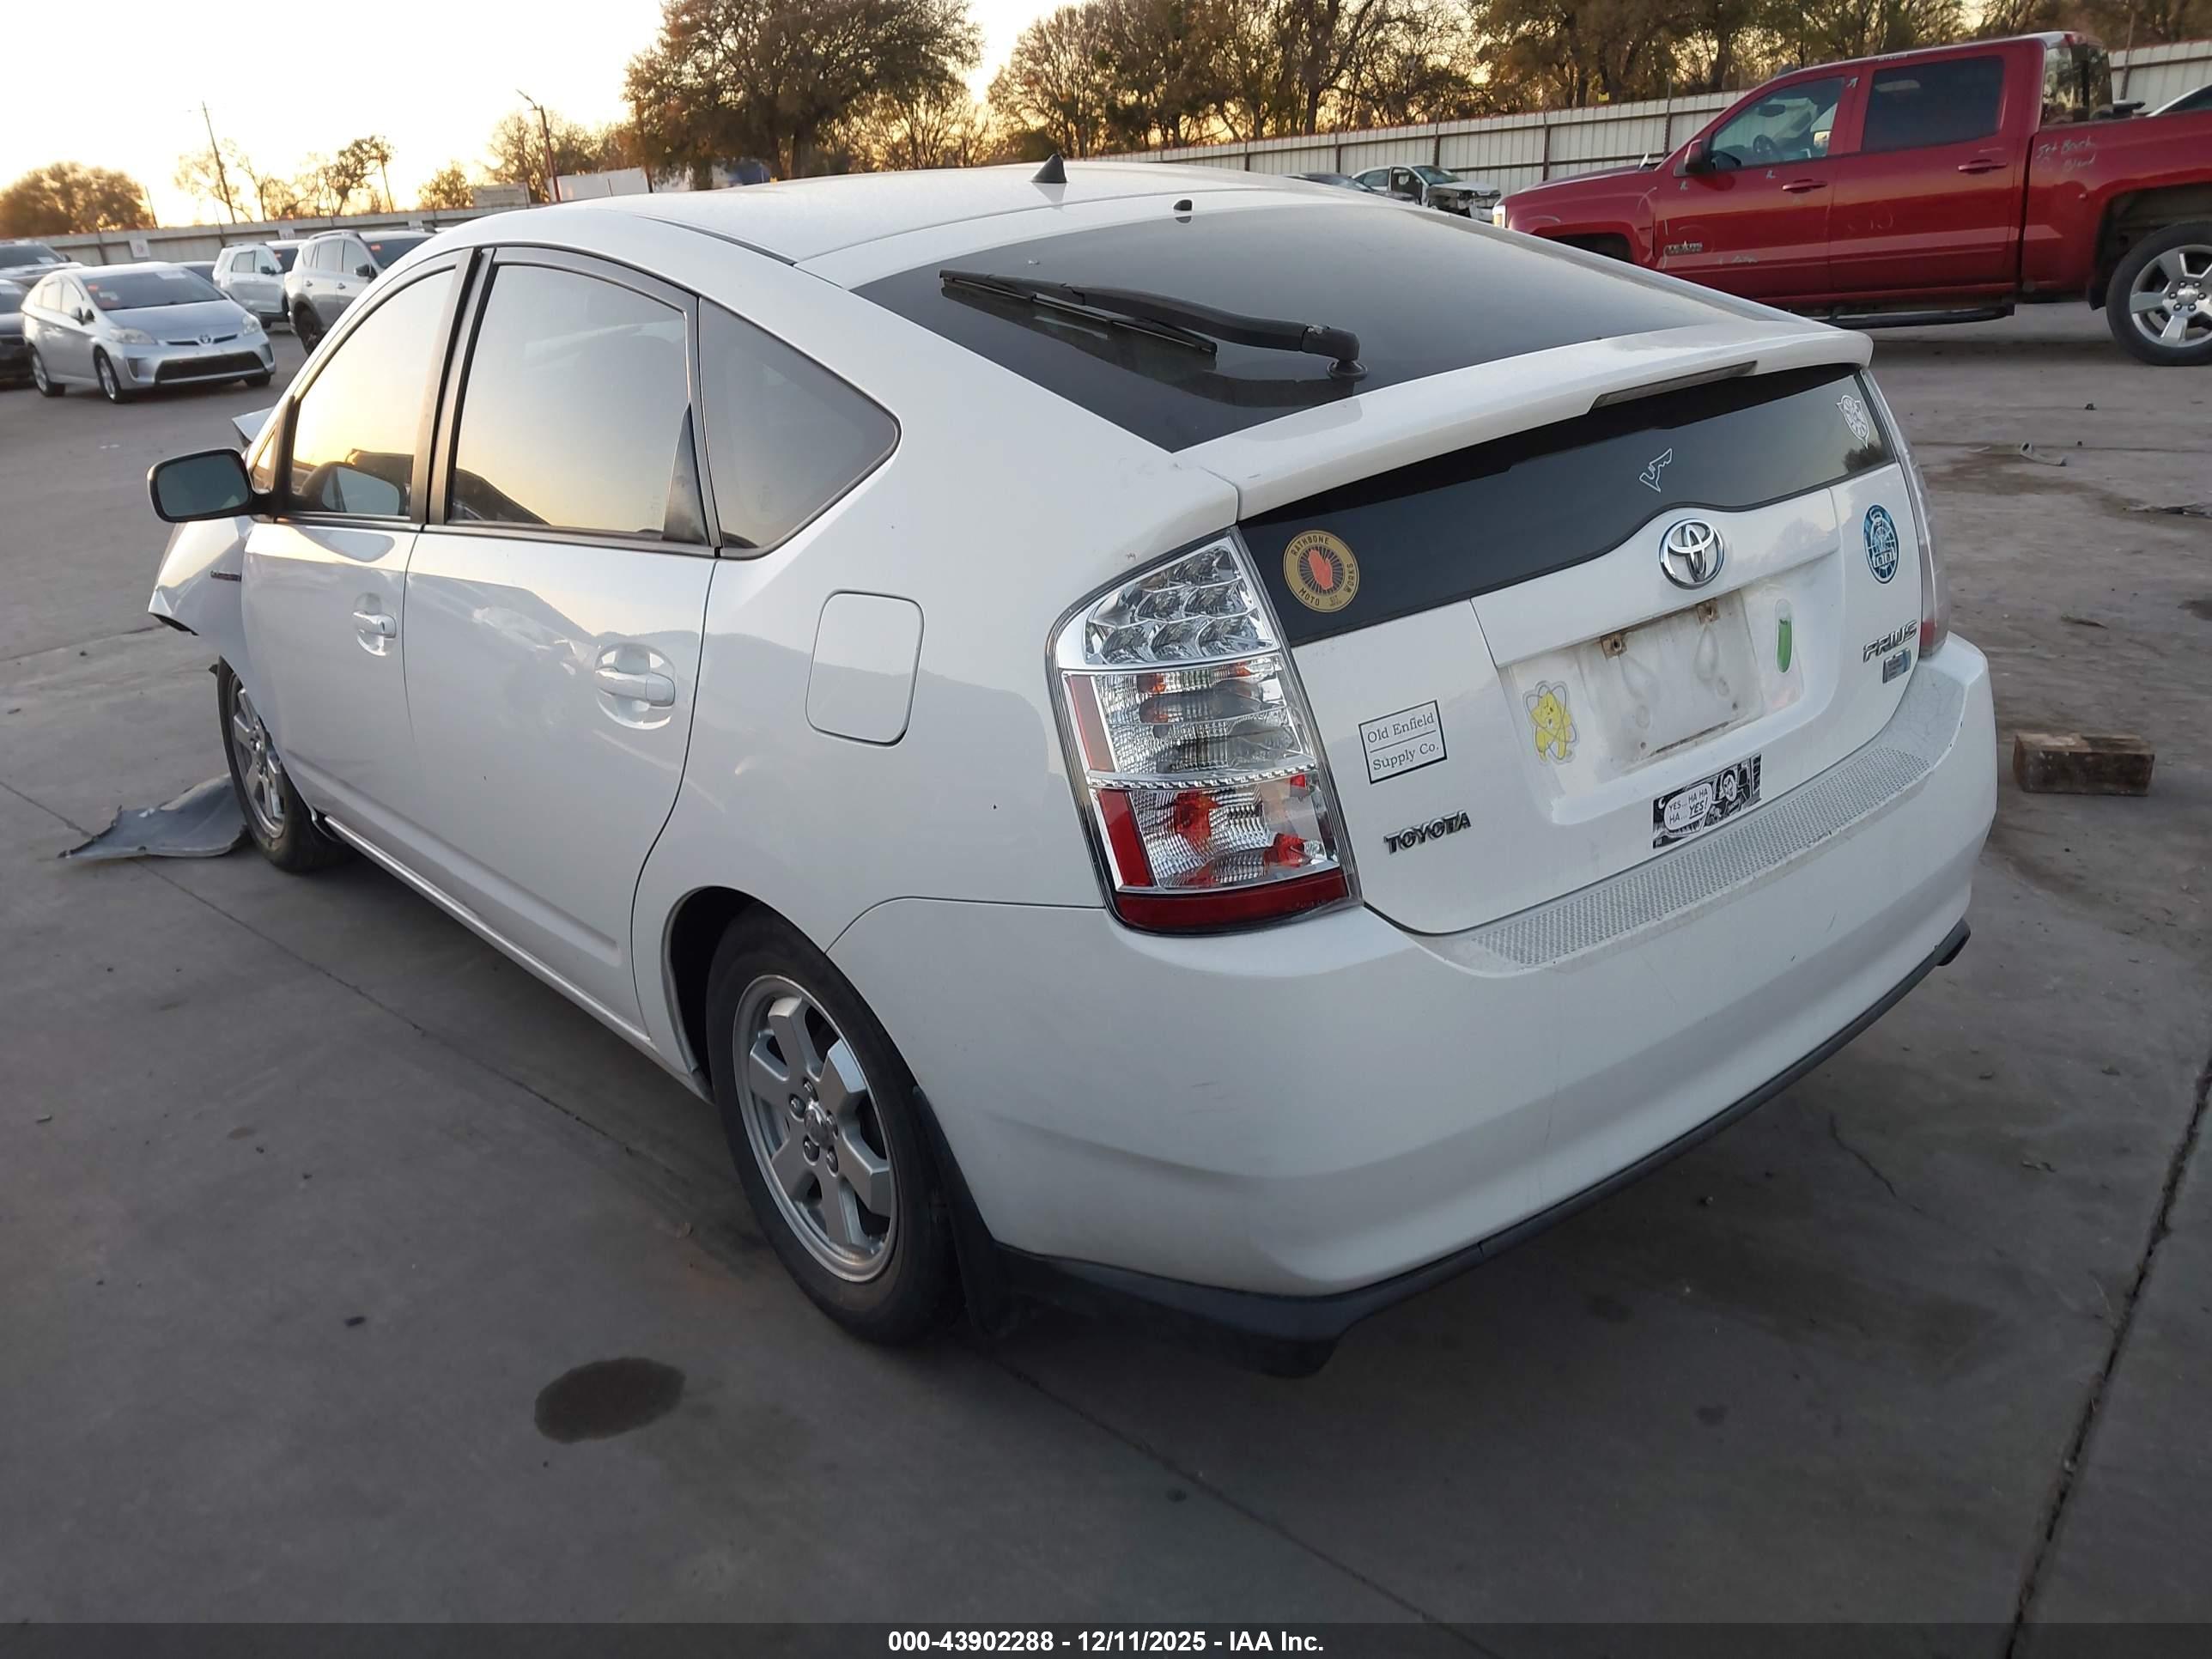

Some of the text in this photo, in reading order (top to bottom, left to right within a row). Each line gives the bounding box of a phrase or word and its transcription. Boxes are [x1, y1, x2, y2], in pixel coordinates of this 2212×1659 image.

[1291, 534, 1330, 556] RATHBONE
[1344, 562, 1355, 593] WORKS
[1297, 587, 1321, 606] MOTO
[1863, 619, 1917, 662] PRIUS
[1367, 712, 1435, 744] Old Enfield
[1373, 743, 1439, 770] Supply Co.
[1688, 792, 1698, 805] HA
[1699, 787, 1708, 799] HA
[1689, 796, 1708, 817] YES!
[1383, 810, 1472, 855] TOYOTA
